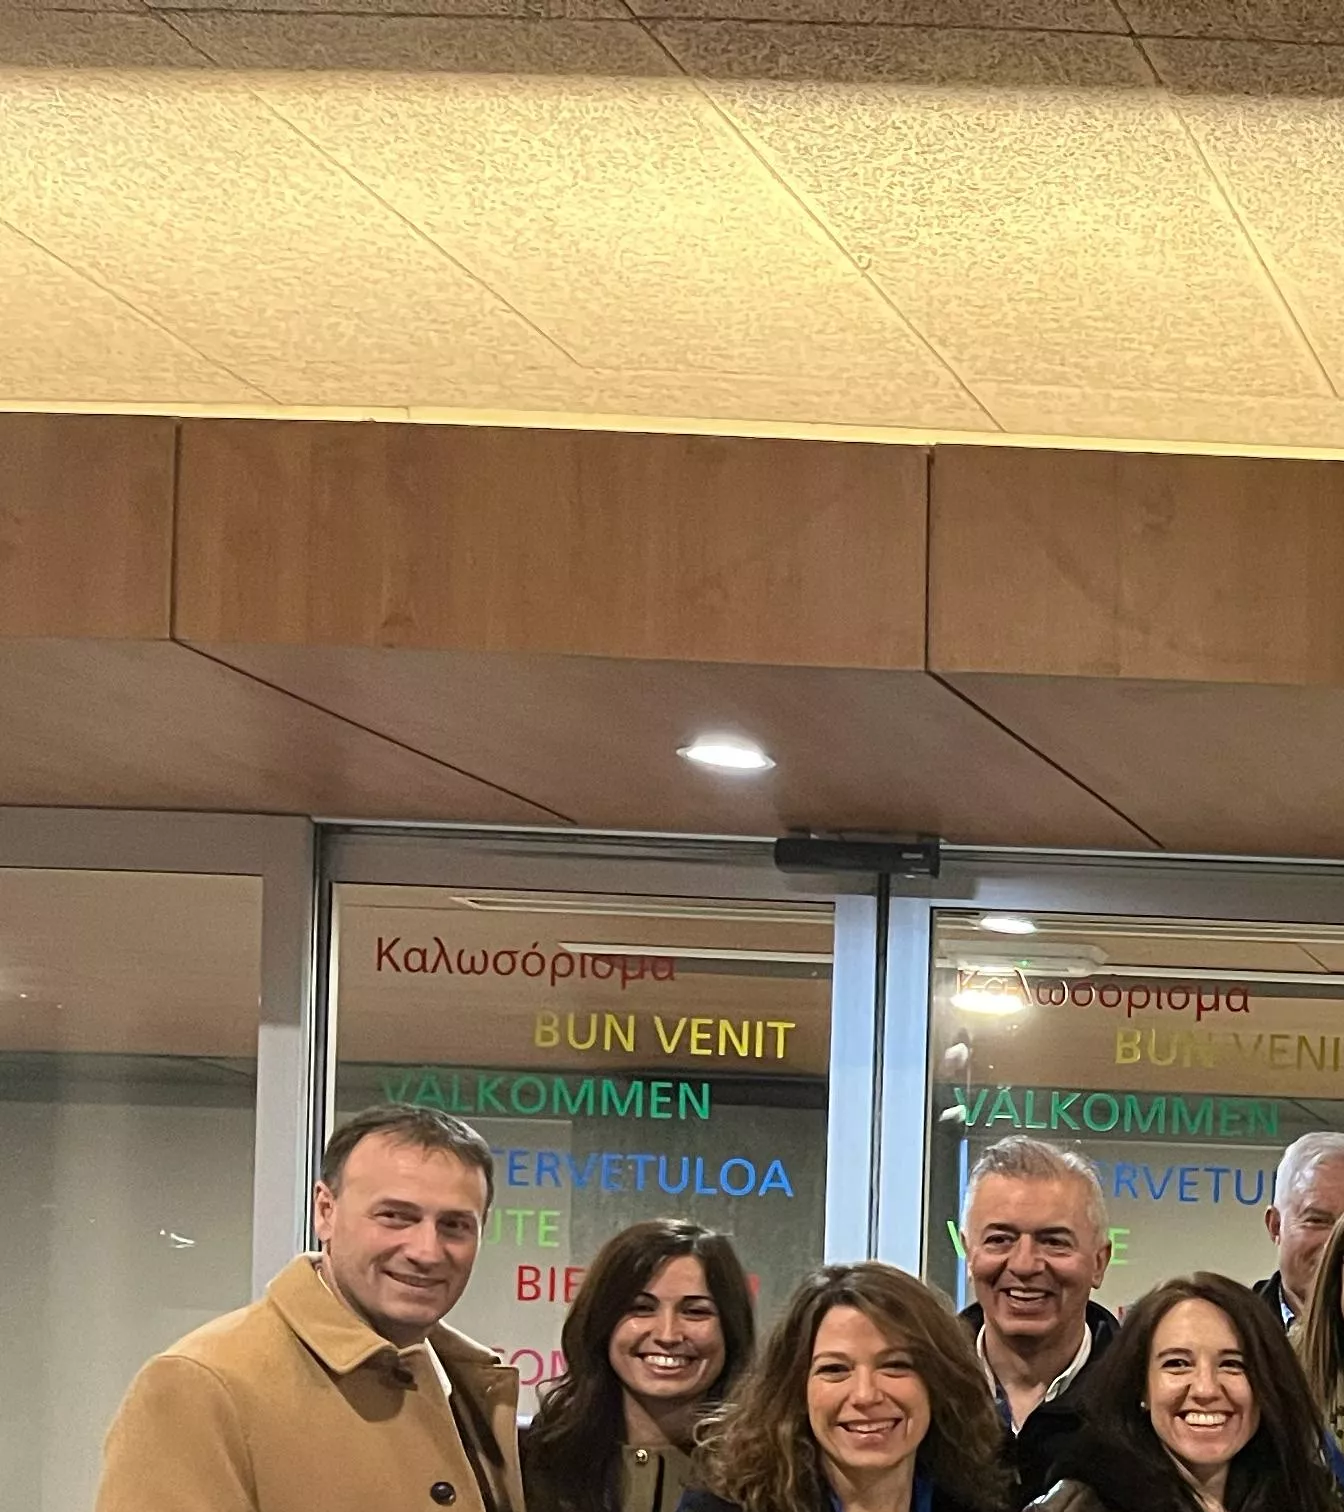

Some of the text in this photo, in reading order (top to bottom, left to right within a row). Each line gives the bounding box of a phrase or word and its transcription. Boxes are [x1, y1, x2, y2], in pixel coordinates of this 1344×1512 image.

[534, 1011, 796, 1059] BUN VENIT
[1115, 1027, 1217, 1068] BUN
[954, 1086, 1278, 1136] VÄLKOMMEN
